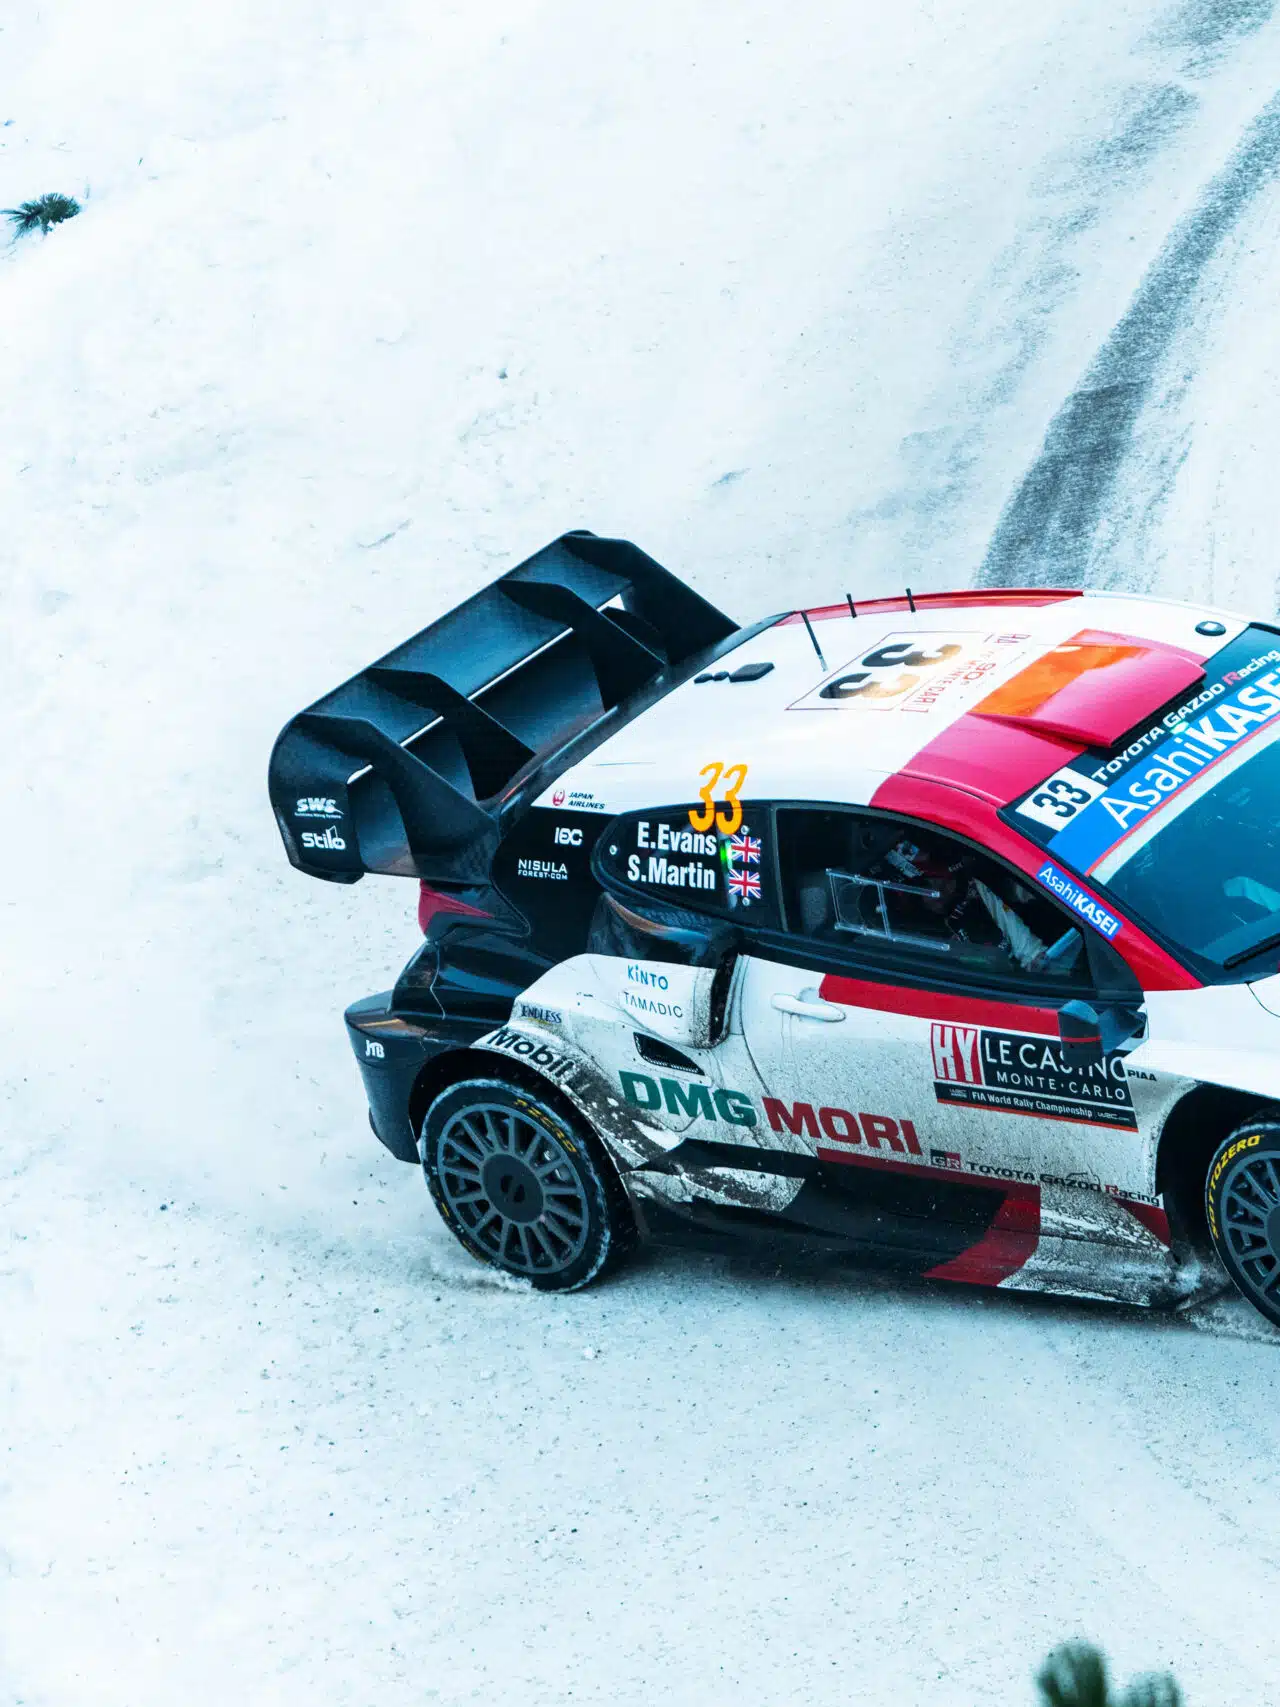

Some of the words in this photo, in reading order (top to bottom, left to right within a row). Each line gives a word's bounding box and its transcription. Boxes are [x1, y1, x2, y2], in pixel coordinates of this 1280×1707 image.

[819, 642, 962, 699] 33
[1091, 726, 1164, 782] TOYOTA
[1163, 683, 1225, 728] GAZOO
[568, 800, 605, 810] AIRLINES
[569, 791, 594, 800] JAPAN
[688, 761, 748, 835] 33
[1032, 779, 1092, 819] 33
[301, 826, 346, 850] Stilo
[637, 821, 717, 856] E.Evans
[518, 858, 568, 874] NISULA
[627, 854, 716, 890] S.Martin
[520, 1003, 563, 1025] ENDLESS
[623, 991, 683, 1018] TAMADIC
[365, 1039, 385, 1058] JTB
[985, 1038, 1013, 1066] LE
[1018, 1043, 1127, 1081] CANO
[1127, 1069, 1157, 1082] PIAA
[618, 1070, 758, 1128] DMG
[762, 1096, 924, 1156] MORI
[971, 1091, 986, 1101] FIA
[986, 1094, 1012, 1105] World
[1013, 1098, 1034, 1109] Rally
[1035, 1101, 1093, 1118] Championship
[931, 1155, 961, 1169] GR
[967, 1161, 1036, 1181] TOYOTA
[1039, 1173, 1101, 1192] GAZOO
[1104, 1184, 1161, 1207] Racing
